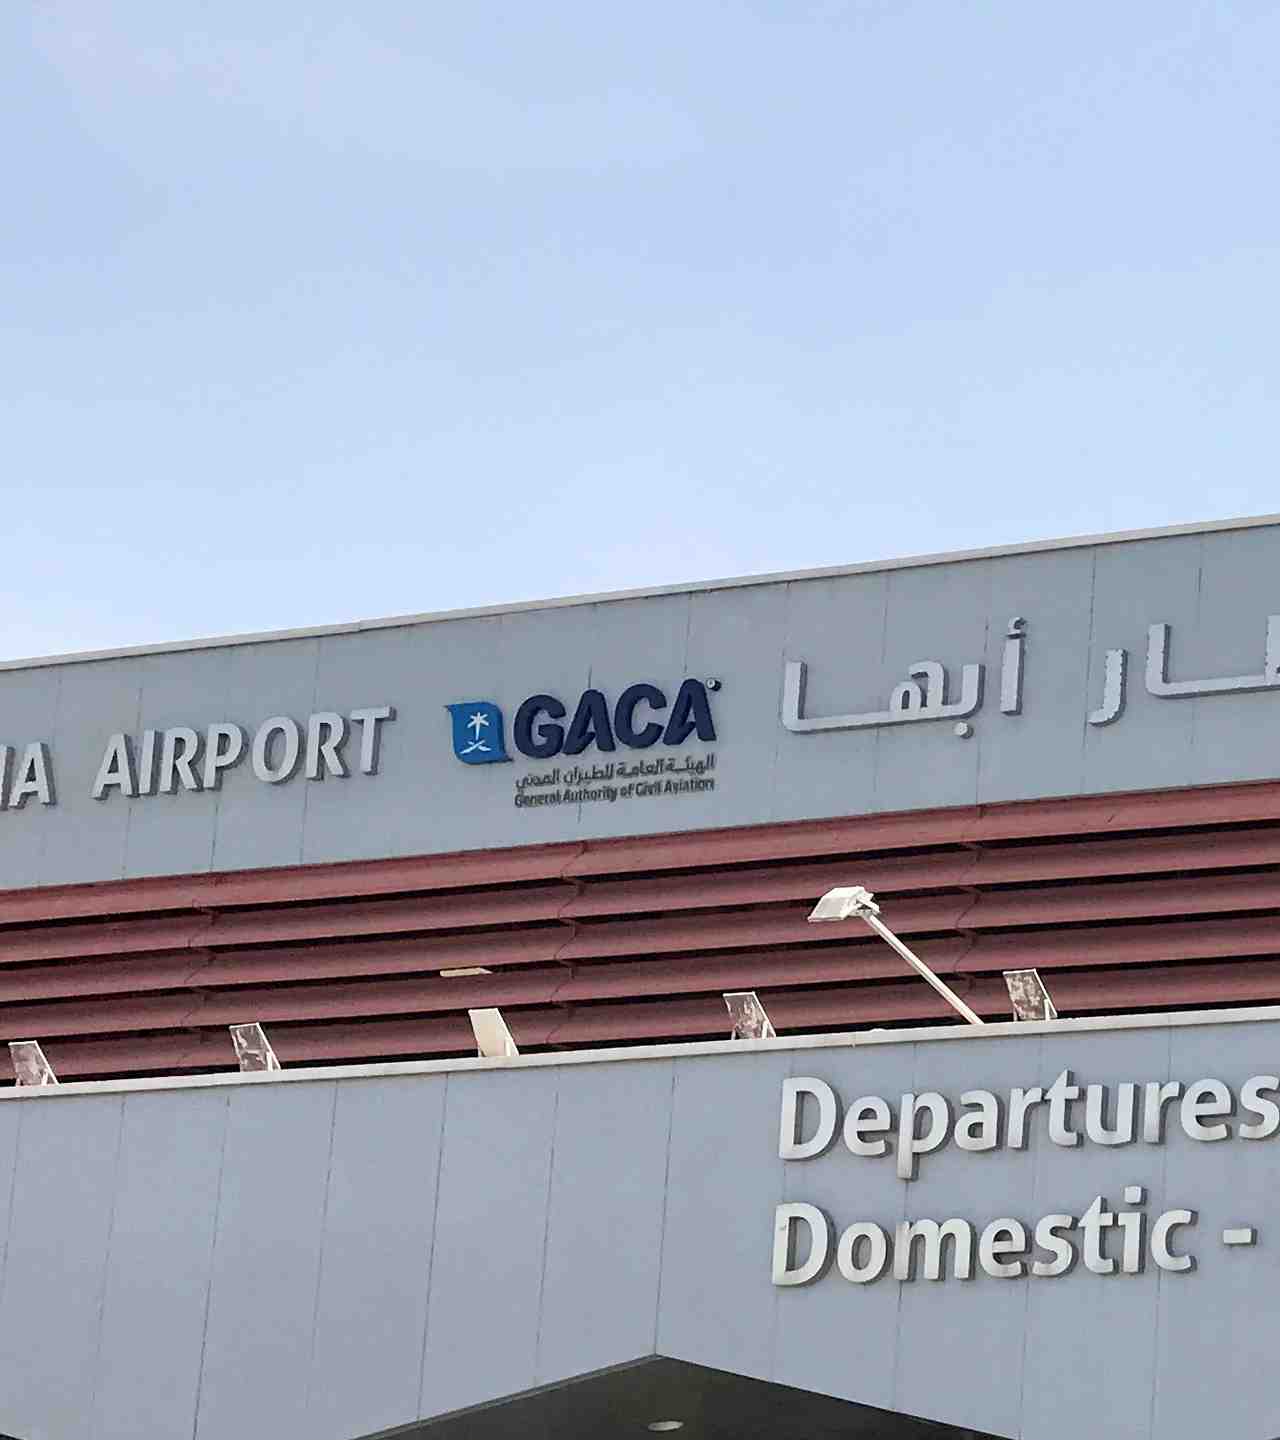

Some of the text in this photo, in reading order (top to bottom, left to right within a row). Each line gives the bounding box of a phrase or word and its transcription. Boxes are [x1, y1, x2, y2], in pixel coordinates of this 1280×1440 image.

[513, 677, 717, 760] GACA
[783, 616, 1028, 738] أبها
[92, 706, 396, 801] AIRPORT
[514, 776, 715, 809] General Authority of Civil Aviation
[772, 1185, 1199, 1287] Domestic
